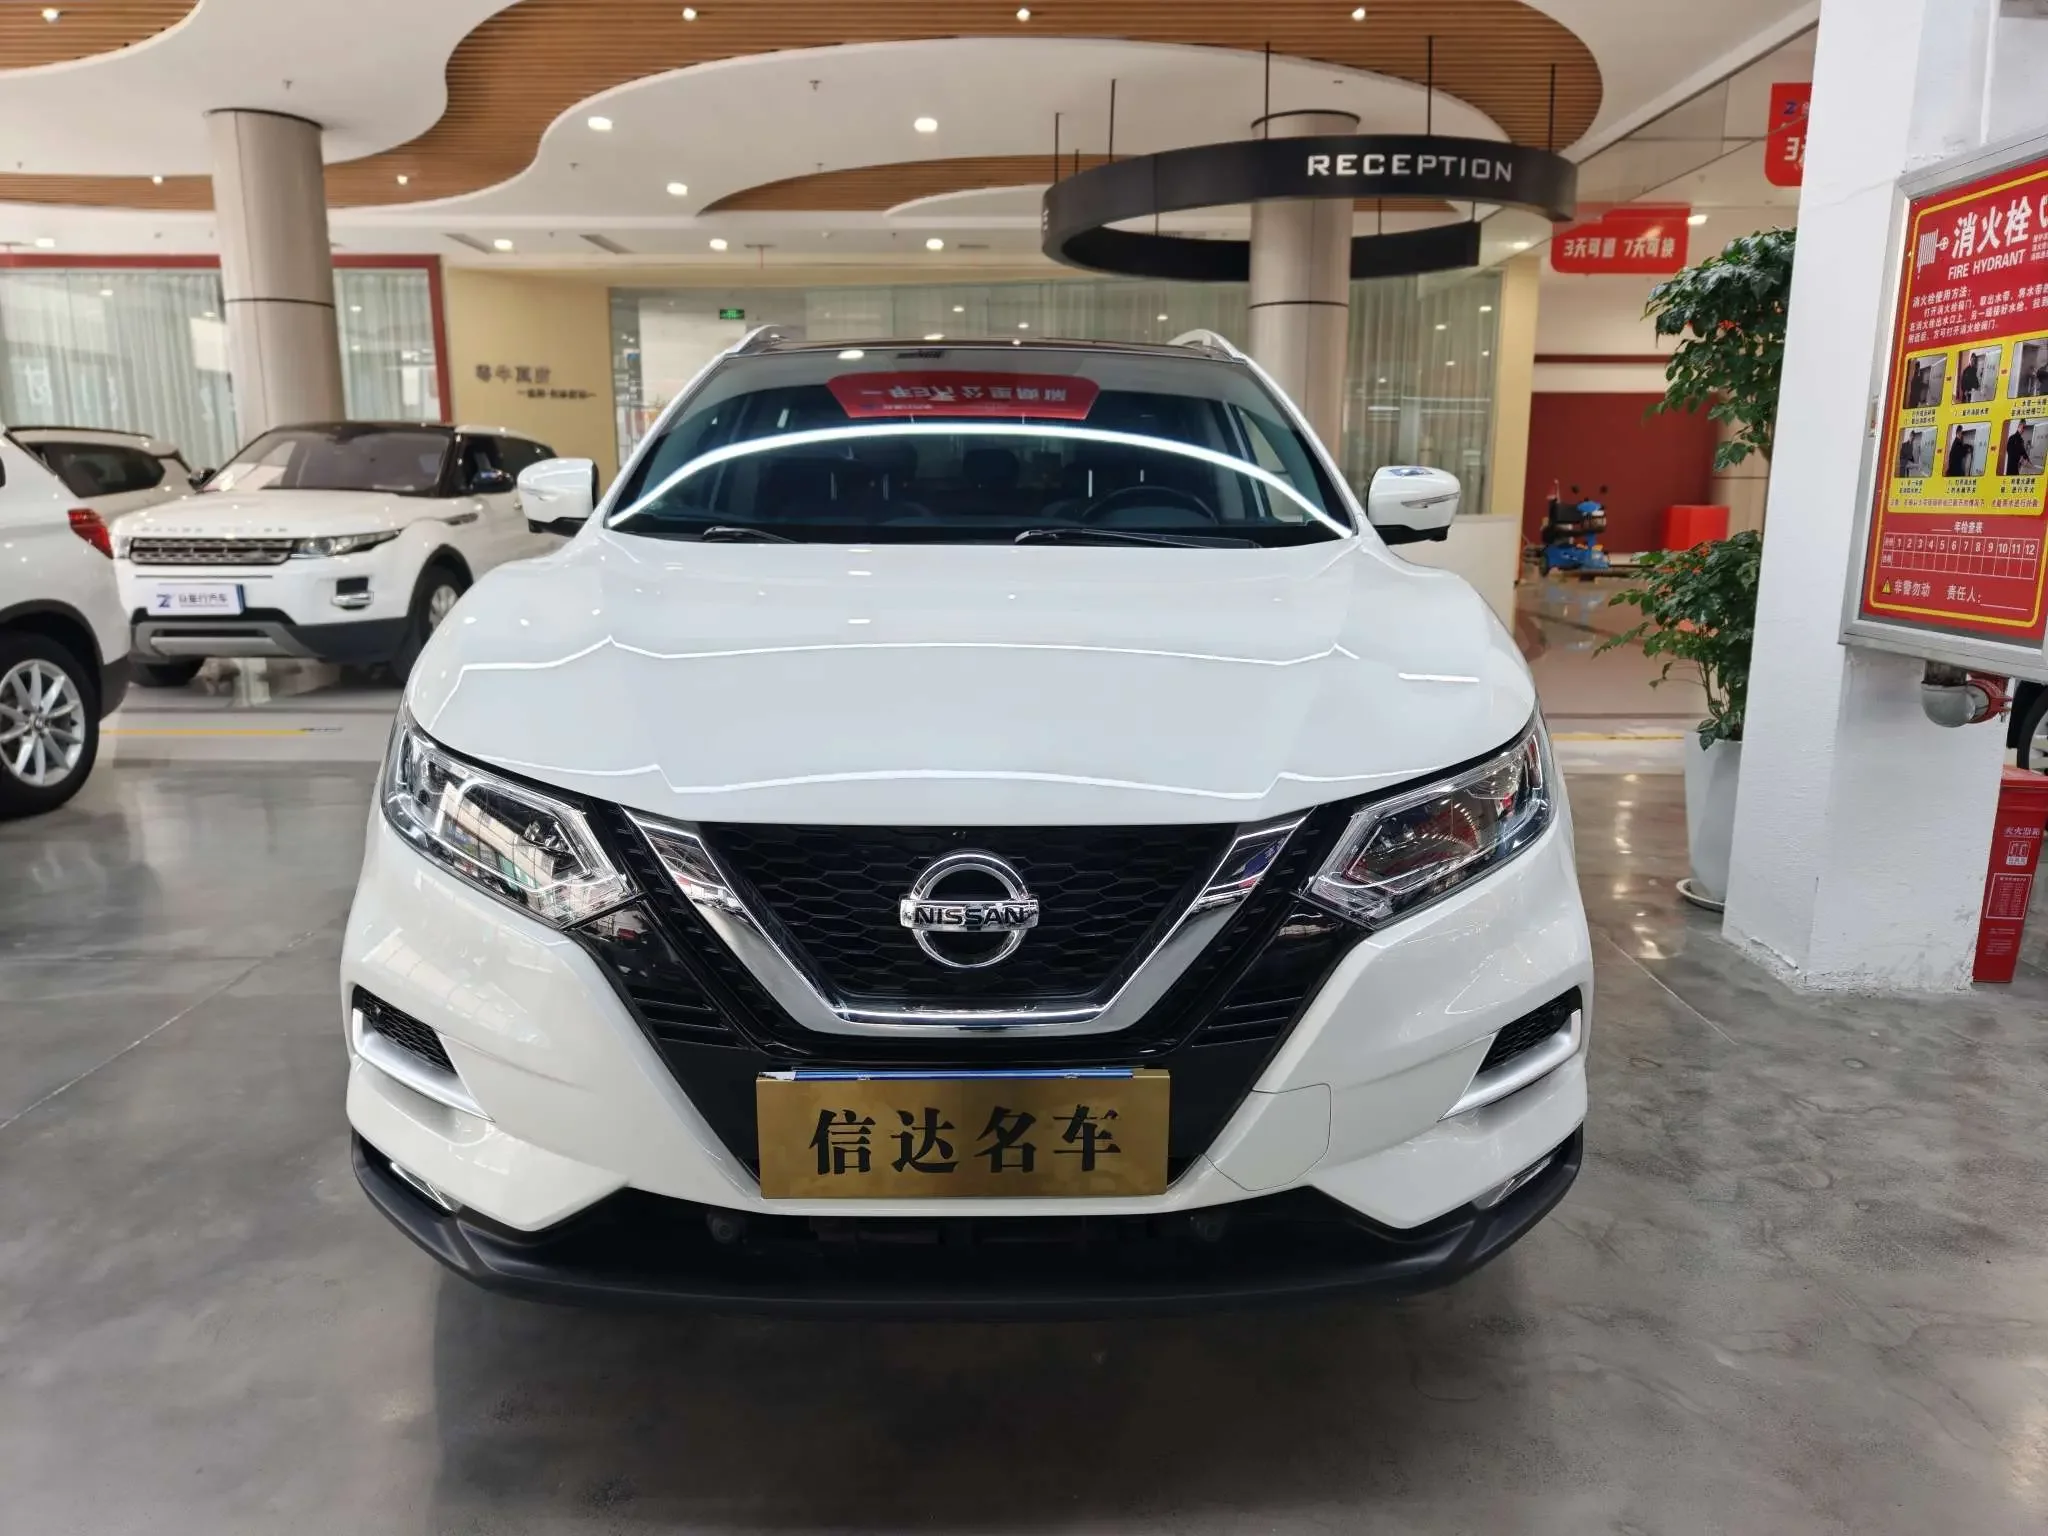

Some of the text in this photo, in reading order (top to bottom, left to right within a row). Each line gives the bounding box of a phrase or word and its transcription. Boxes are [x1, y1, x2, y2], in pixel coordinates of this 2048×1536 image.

[1307, 154, 1512, 182] RECEPTION
[1951, 195, 2032, 259] 消火栓
[1948, 249, 2026, 280] FIRE HYDRANT
[1998, 543, 2008, 554] 10
[2012, 544, 2020, 554] 11
[2025, 544, 2036, 555] 12
[914, 907, 1024, 925] NISSAN
[808, 1104, 1122, 1175] 信达名车
